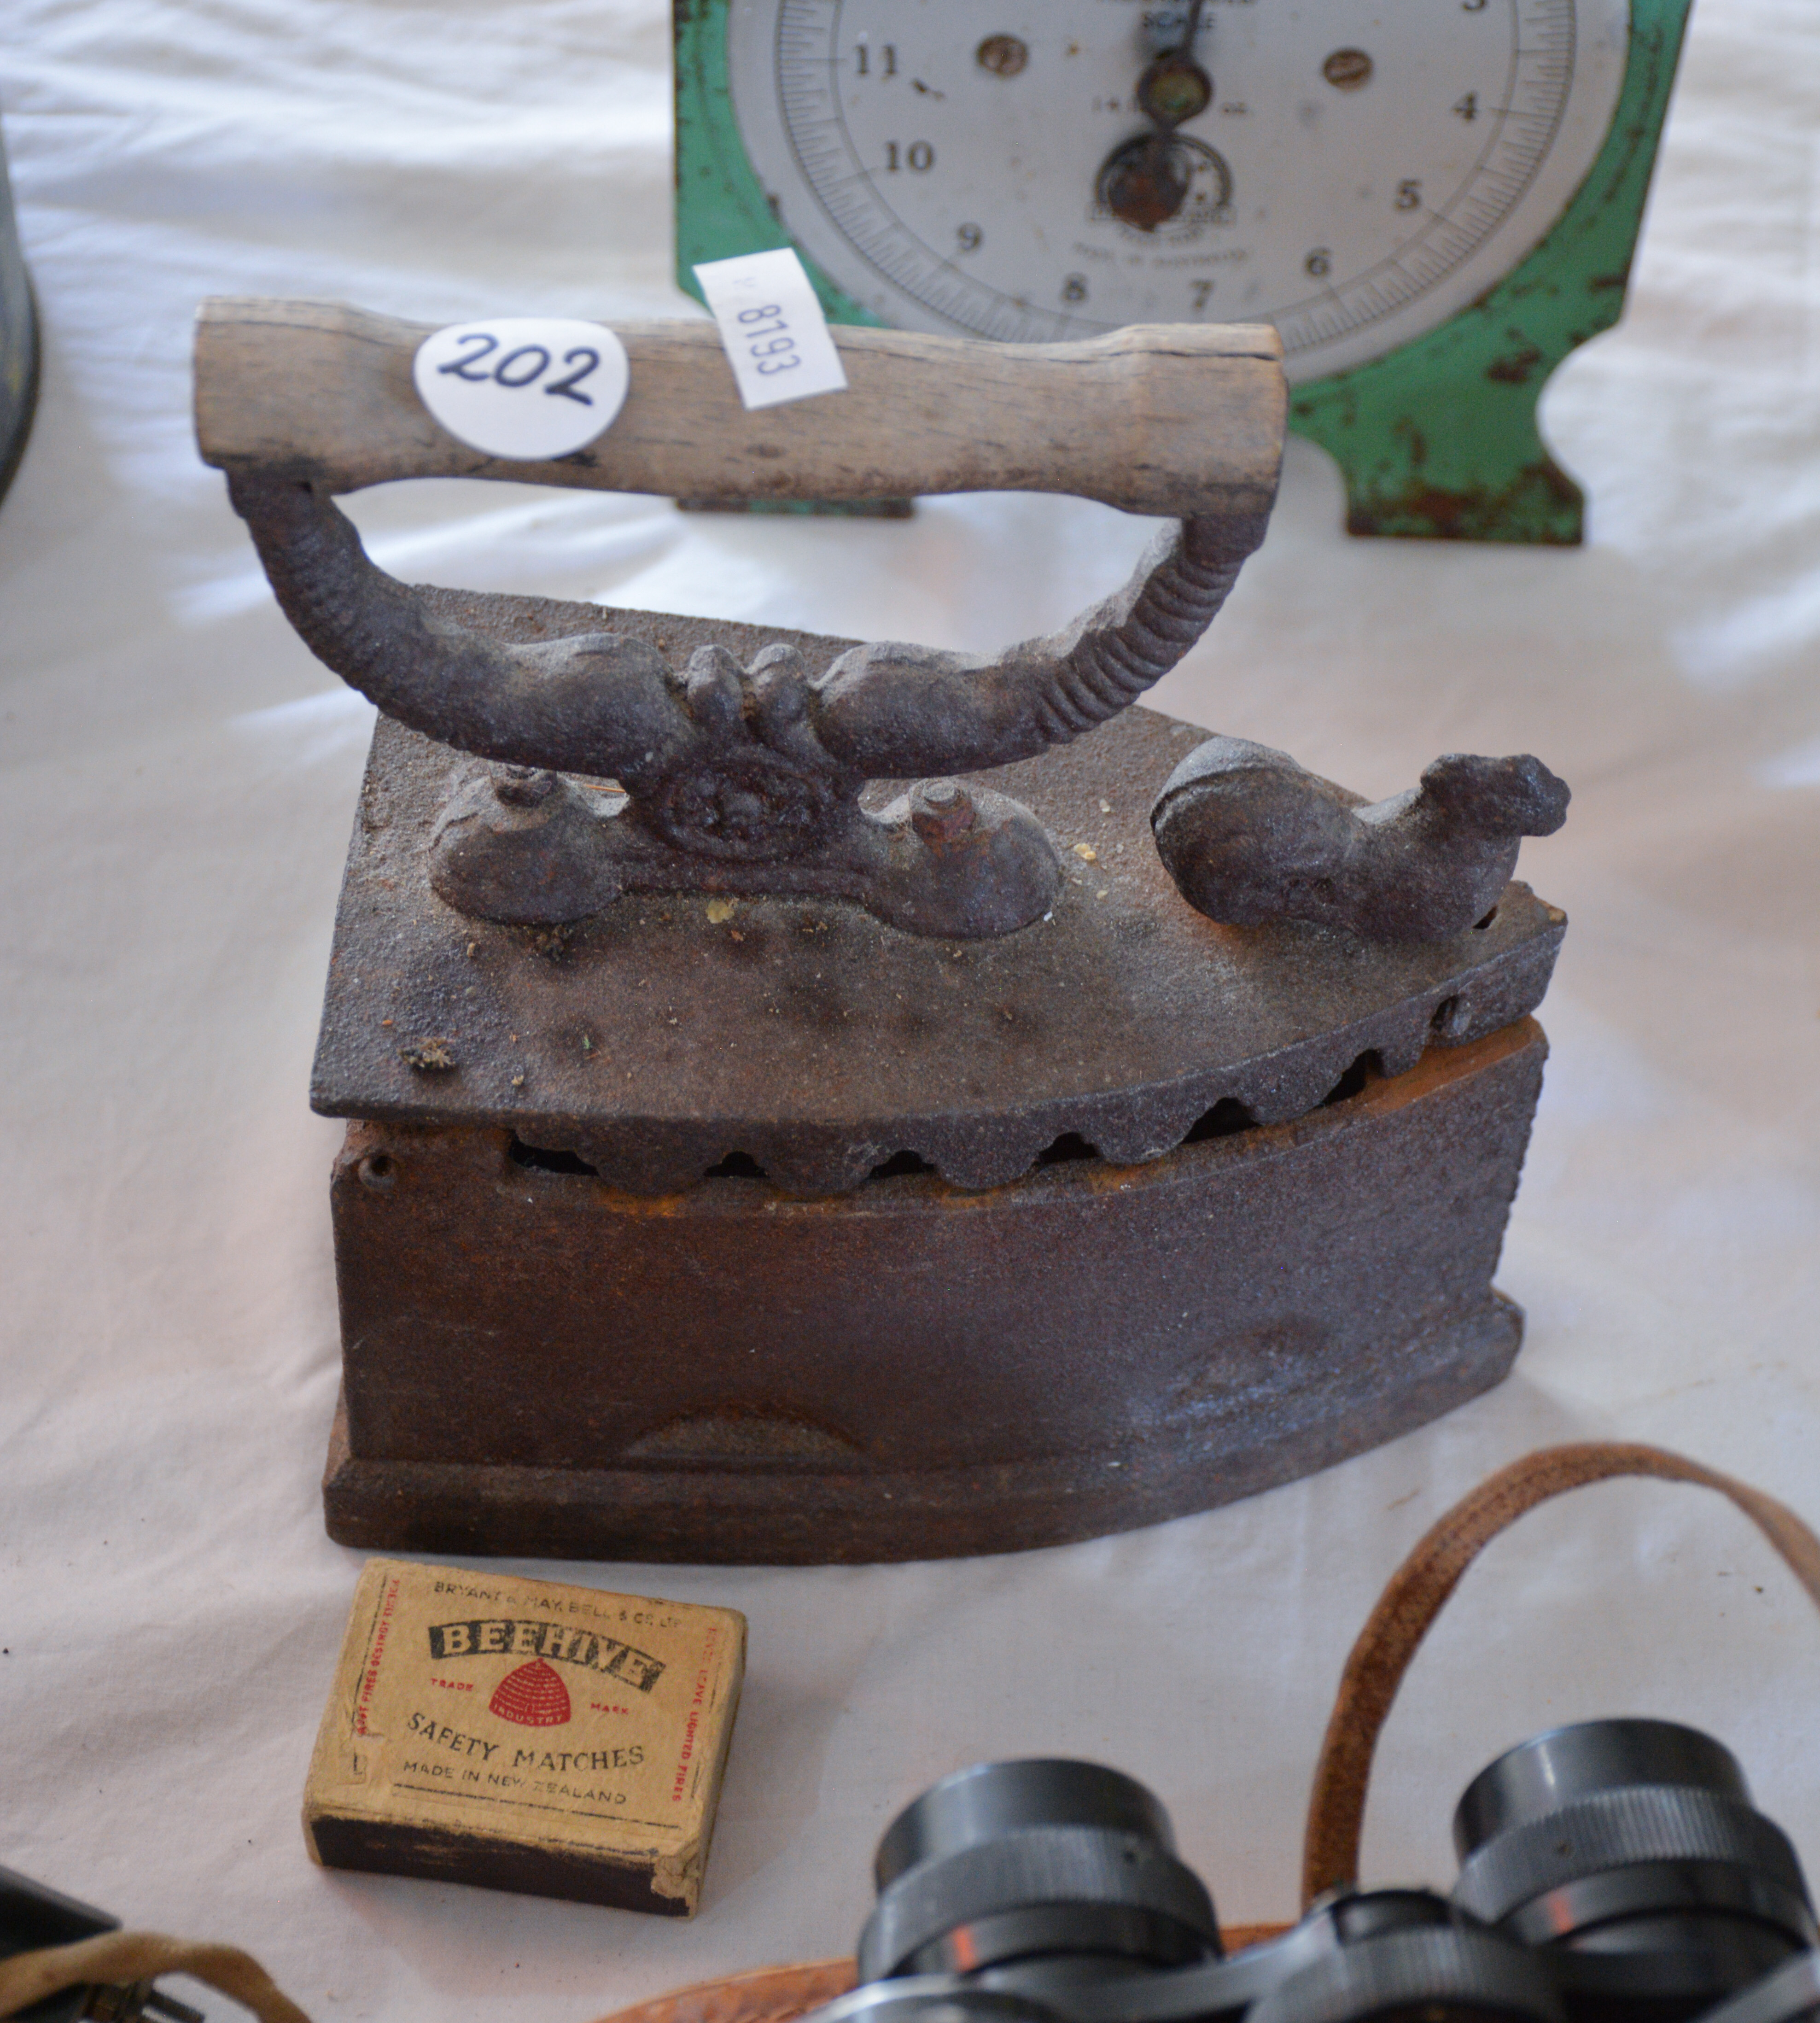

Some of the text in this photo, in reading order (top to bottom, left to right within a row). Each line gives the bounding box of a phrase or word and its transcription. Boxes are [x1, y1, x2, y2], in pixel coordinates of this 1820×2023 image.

[855, 44, 898, 75] 11
[1451, 91, 1477, 121] 4
[885, 140, 935, 173] 10
[1393, 178, 1422, 213] 5
[957, 222, 982, 254] 9
[1304, 247, 1331, 280] 6
[1062, 273, 1087, 306] 8
[1189, 280, 1214, 311] 7
[737, 303, 802, 376] 8193
[436, 332, 601, 406] 202
[441, 1620, 656, 1686] BEEHIVE
[431, 1678, 473, 1692] TRADE
[492, 1703, 562, 1724] INDUSTRY
[590, 1702, 630, 1715] MARK
[407, 1712, 645, 1772] SAFETY MATCHES
[403, 1760, 627, 1805] MADE IN NEW ZEALAND
[672, 1764, 688, 1801] FIRES
